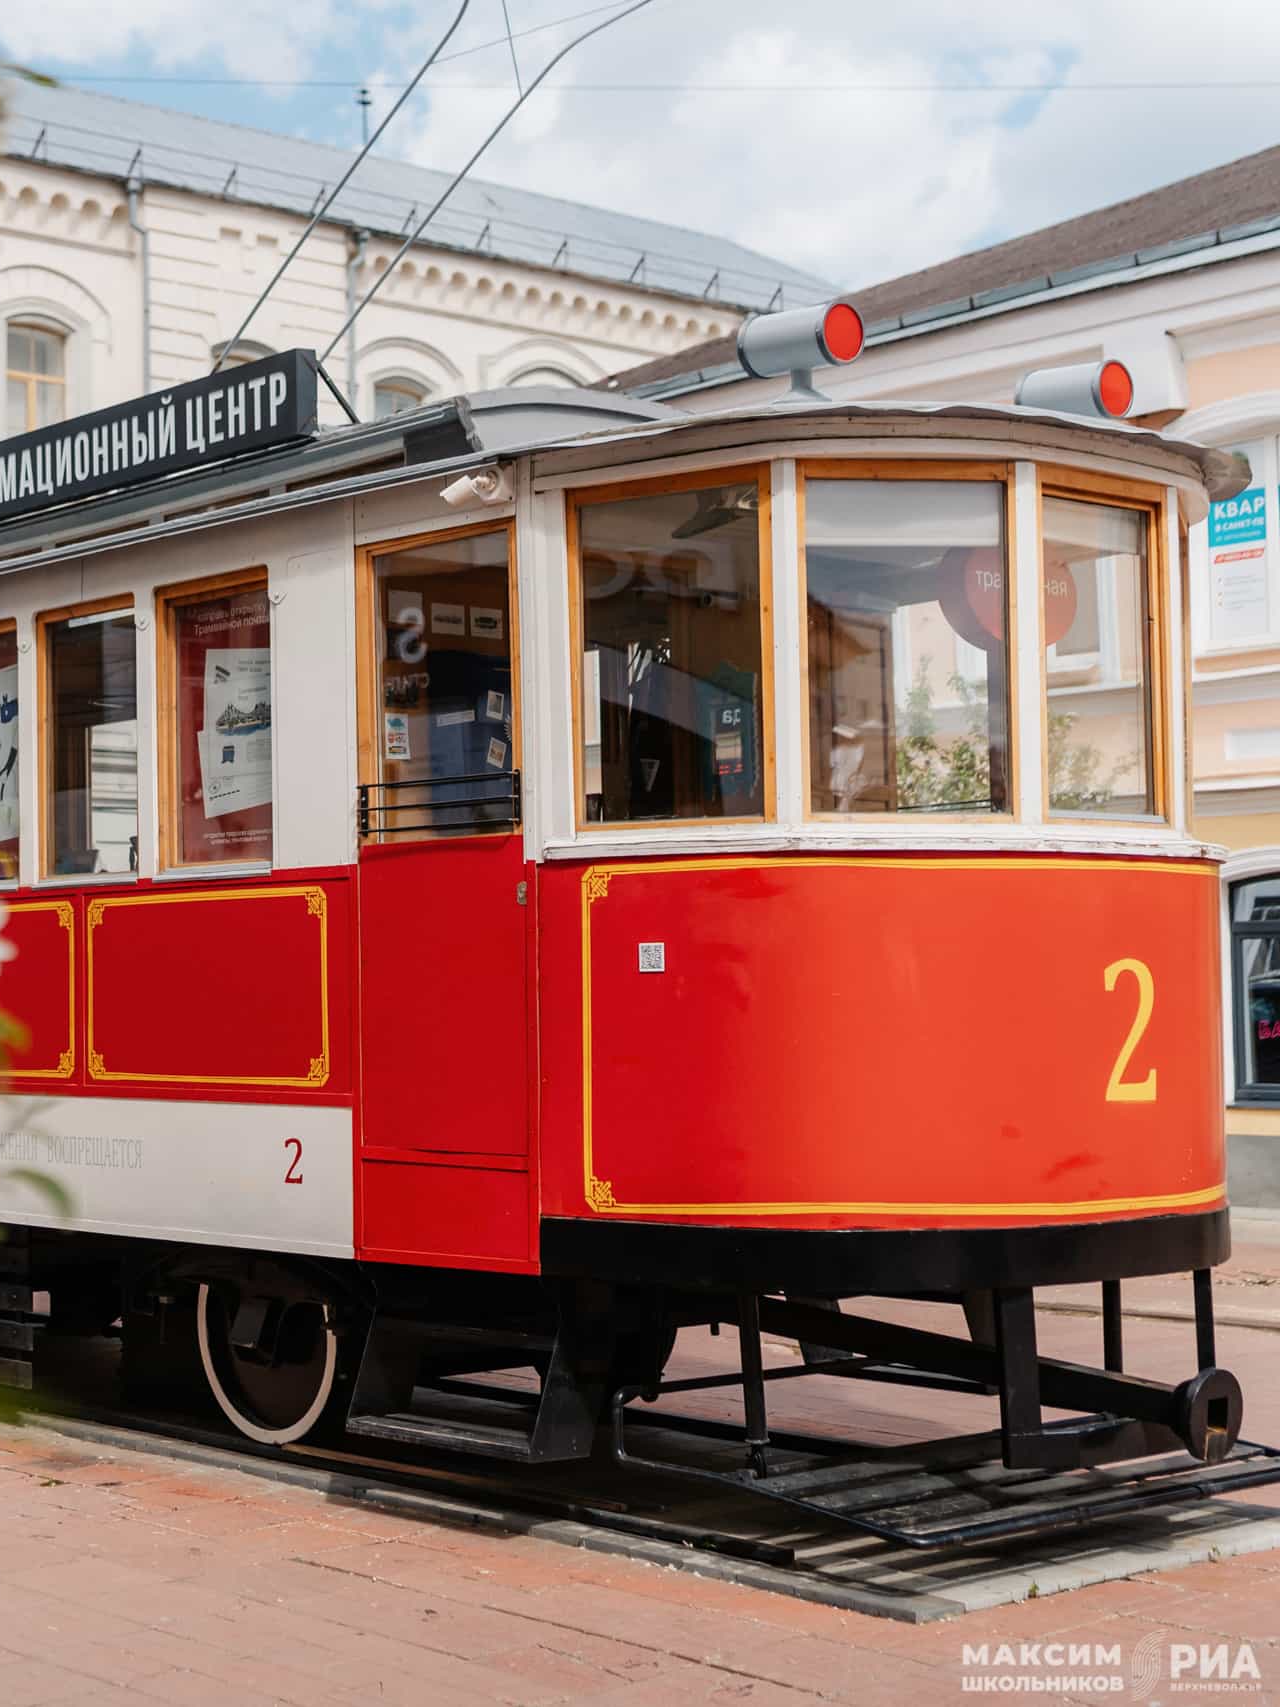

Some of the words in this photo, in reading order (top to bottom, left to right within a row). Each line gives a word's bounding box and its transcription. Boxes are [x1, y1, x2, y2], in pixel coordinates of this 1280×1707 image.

[185, 370, 288, 454] ЦЕНТР
[1104, 957, 1157, 1102] 2
[47, 1135, 145, 1169] ВОСПРЕЩАЕТСЯ
[284, 1138, 303, 1184] 2
